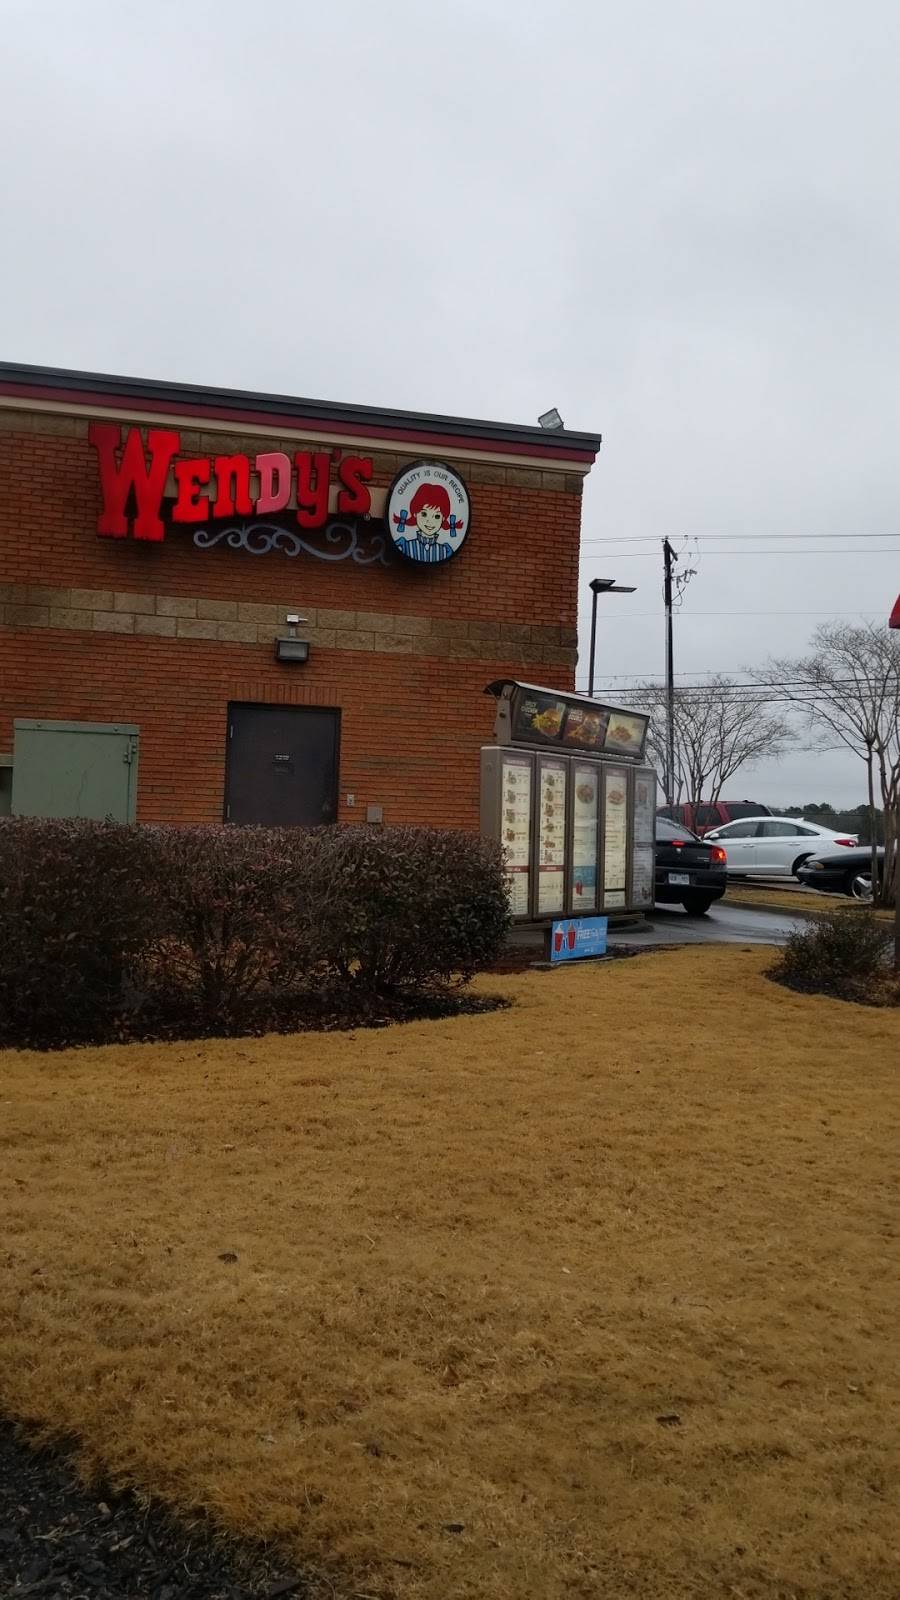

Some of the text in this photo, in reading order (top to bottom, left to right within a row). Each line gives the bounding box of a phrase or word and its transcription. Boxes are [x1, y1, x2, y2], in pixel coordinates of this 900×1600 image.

[397, 472, 421, 495] QUALITY
[433, 471, 448, 481] OUR
[448, 480, 465, 504] RECIPE
